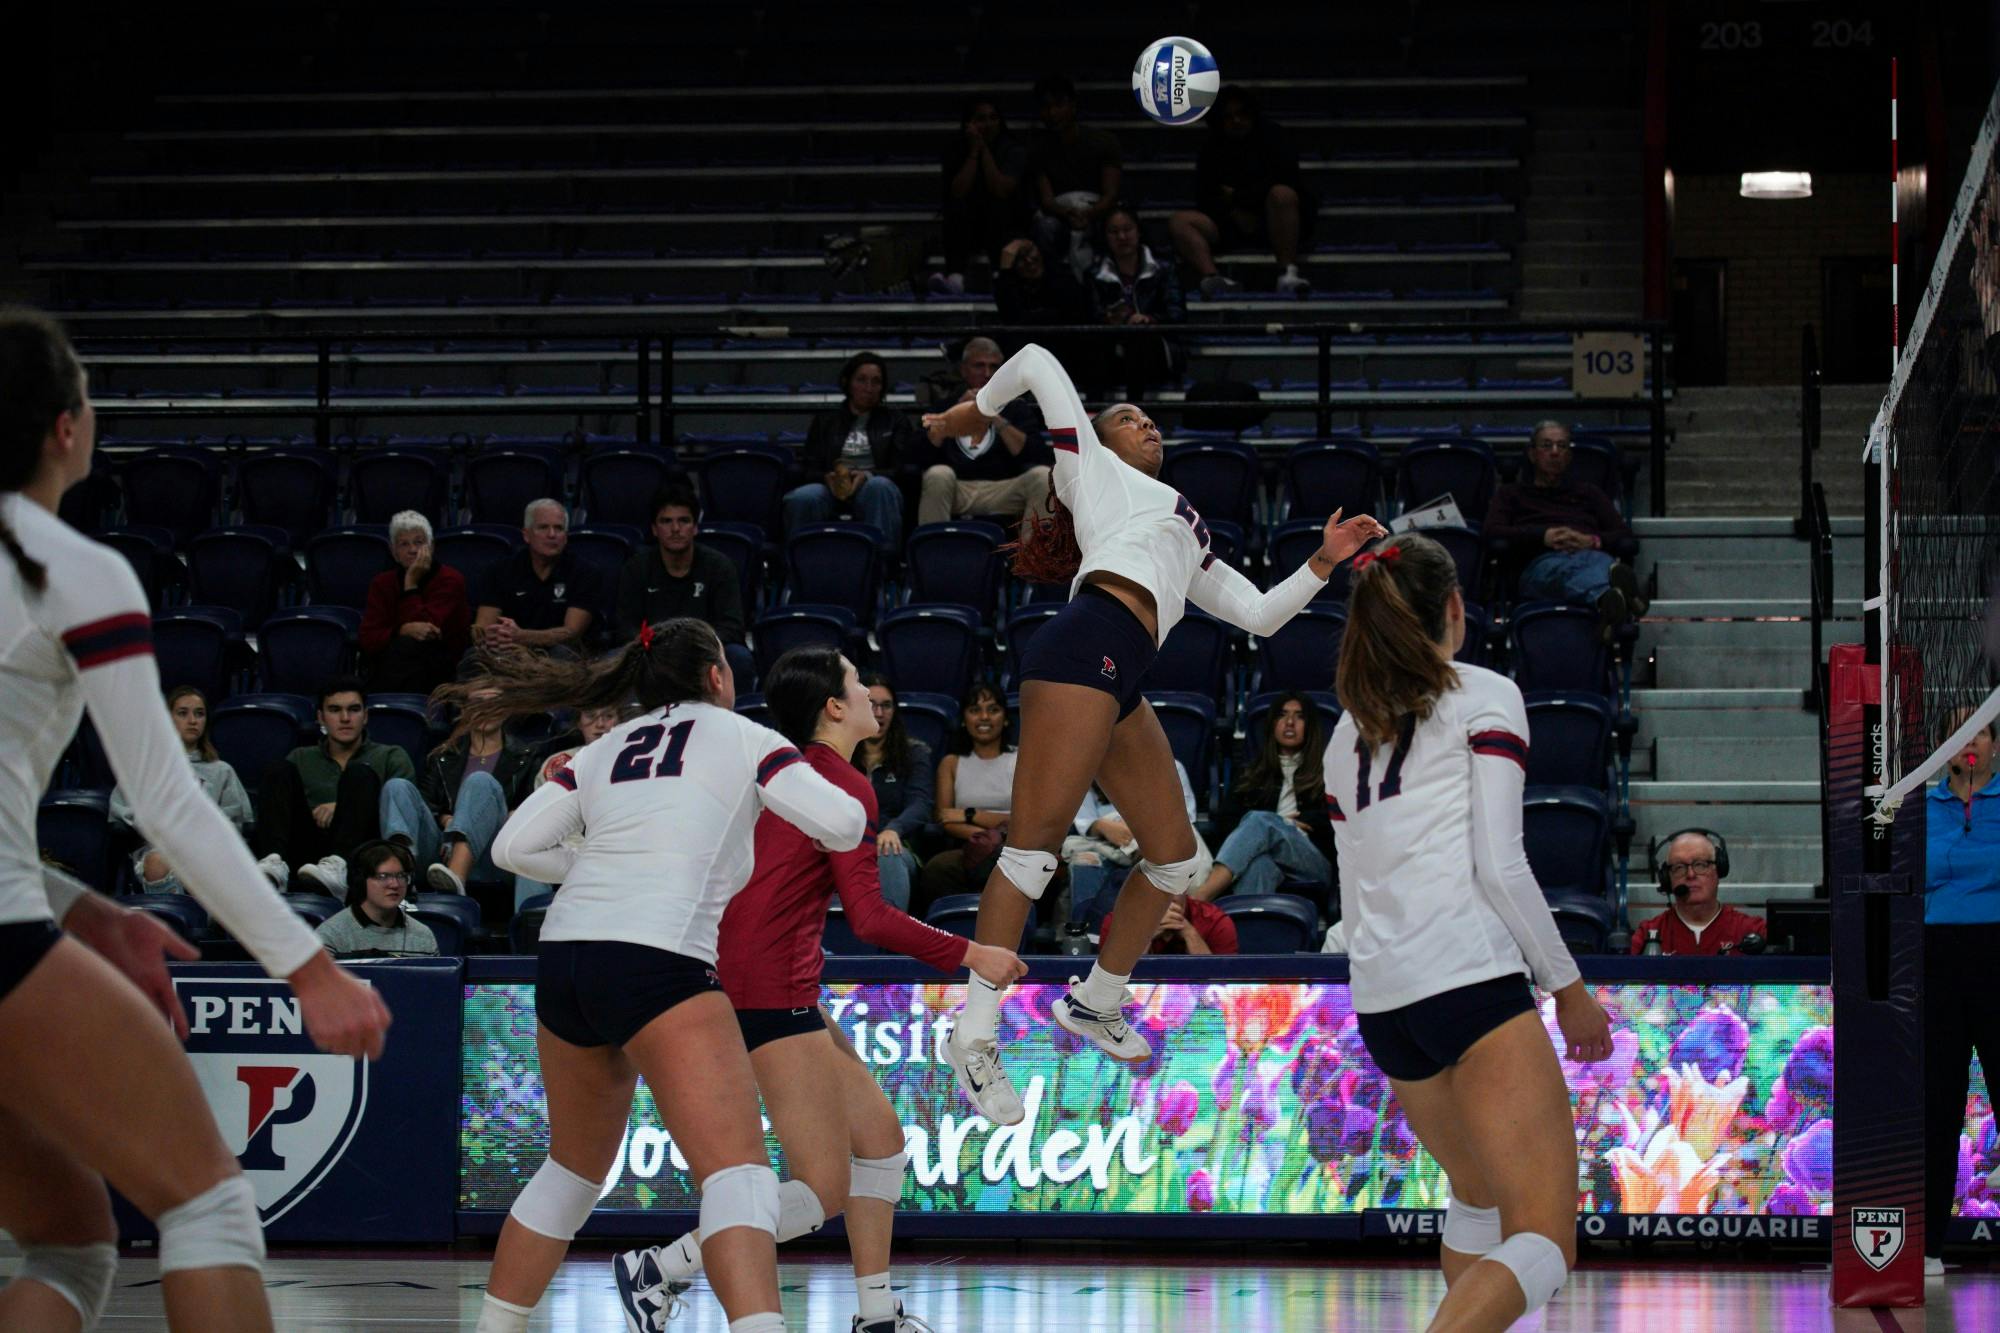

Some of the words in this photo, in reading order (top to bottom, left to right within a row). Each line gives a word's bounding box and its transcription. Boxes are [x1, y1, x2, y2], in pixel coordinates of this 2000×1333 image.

[1700, 20, 1763, 50] 203
[1810, 19, 1874, 48] 204
[1174, 56, 1186, 105] molten
[1583, 351, 1634, 375] 103
[610, 719, 695, 784] 21
[190, 996, 303, 1035] PEN
[903, 1075, 1158, 1190] arden
[1577, 1215, 1606, 1236] O
[1628, 1216, 1820, 1239] MACQUARIE
[1856, 1211, 1900, 1224] PENN
[1971, 1221, 2000, 1240] A
